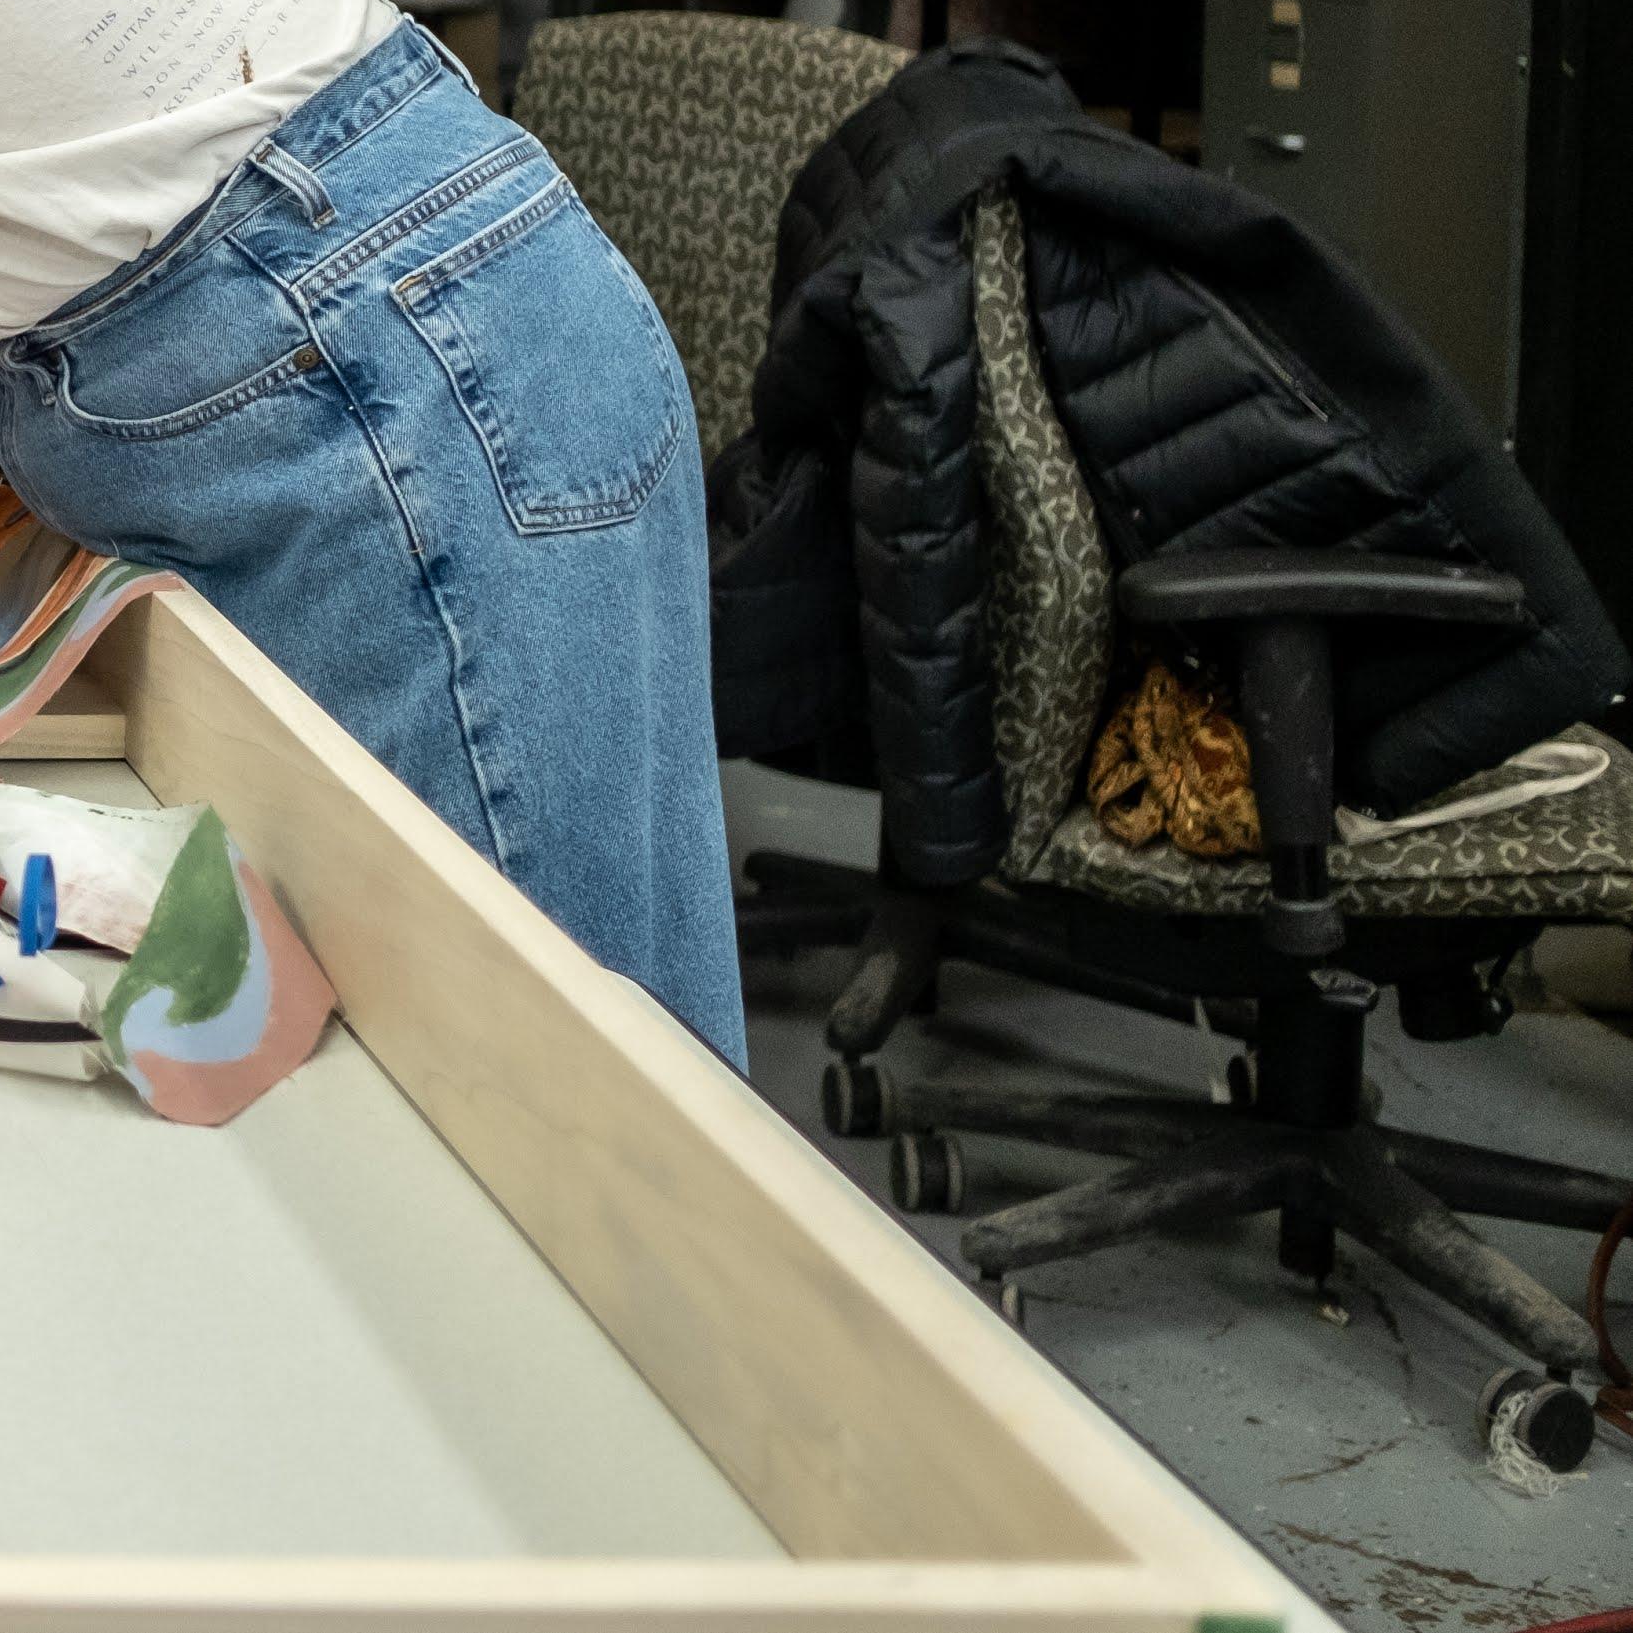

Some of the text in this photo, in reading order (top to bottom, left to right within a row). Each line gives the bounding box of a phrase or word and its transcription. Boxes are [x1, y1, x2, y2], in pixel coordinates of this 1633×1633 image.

[84, 9, 118, 45] THIS
[103, 6, 157, 65] GUITAR
[142, 56, 182, 100] DON
[185, 2, 225, 50] SNOW
